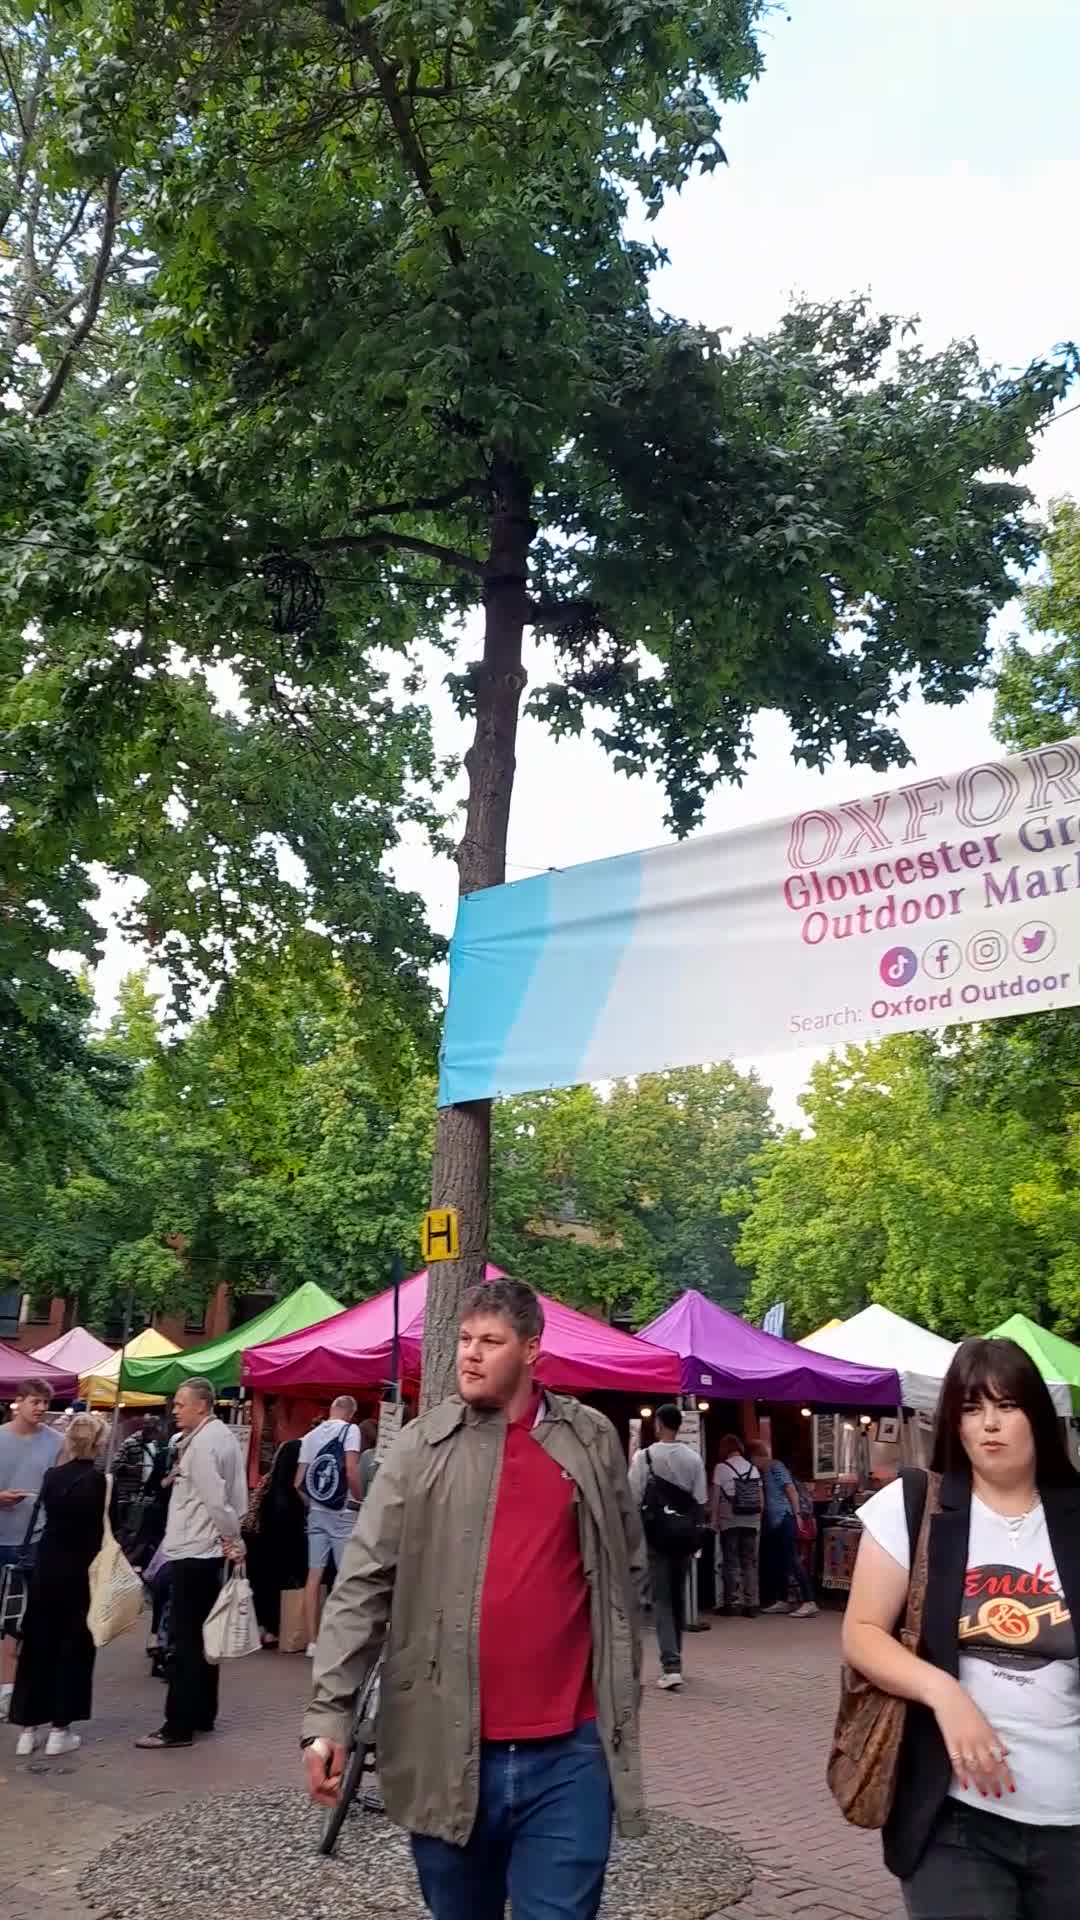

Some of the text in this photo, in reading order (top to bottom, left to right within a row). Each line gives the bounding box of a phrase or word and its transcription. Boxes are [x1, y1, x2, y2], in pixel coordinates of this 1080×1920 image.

[784, 814, 1080, 910] Gloucester Gr
[801, 886, 967, 945] Outdoor
[789, 1007, 862, 1033] Search:
[871, 988, 952, 1019] Oxford
[961, 972, 1070, 1004] Outdoor
[427, 1213, 451, 1256] H
